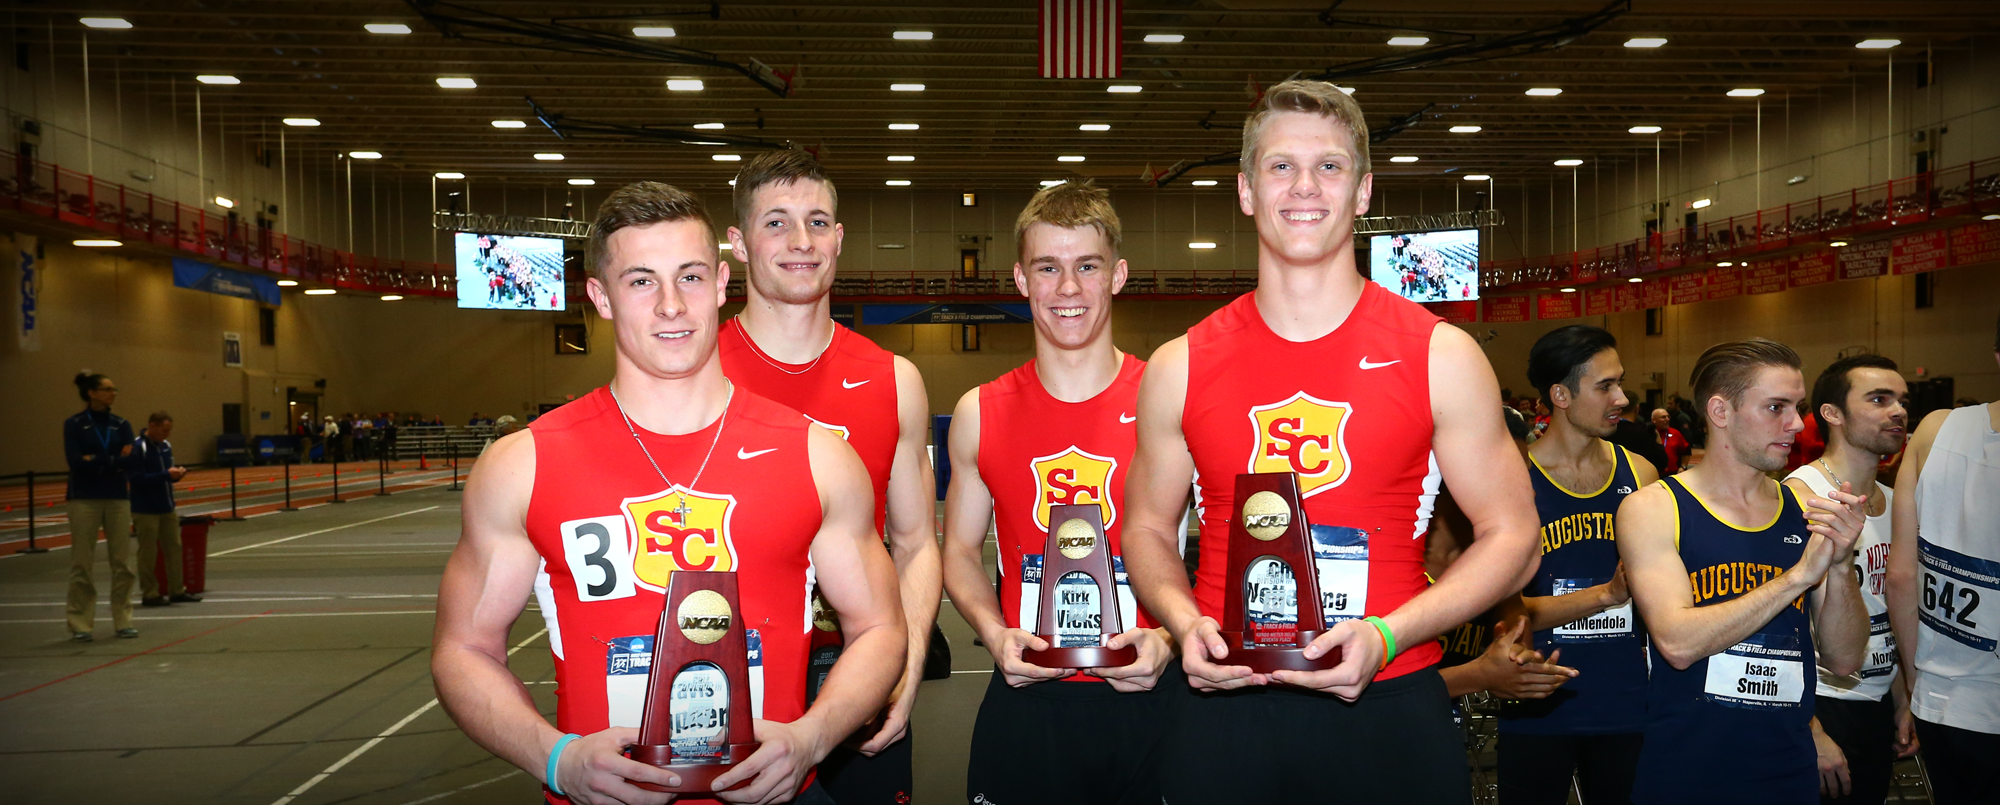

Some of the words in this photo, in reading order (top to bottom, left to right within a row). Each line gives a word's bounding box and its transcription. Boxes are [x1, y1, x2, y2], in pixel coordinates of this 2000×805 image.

[1266, 417, 1333, 478] SC
[1046, 468, 1100, 505] SC
[645, 509, 719, 572] SC
[1541, 512, 1615, 556] AUGUSTA
[1314, 543, 1364, 554] MPIONSHIPS
[575, 522, 617, 597] 3
[1062, 590, 1090, 605] Kirk
[1923, 572, 1980, 629] 642
[681, 615, 730, 630] NCAA
[1730, 645, 1746, 653] RACK
[630, 657, 652, 668] TRAC
[1745, 662, 1777, 677] Isaac
[1737, 677, 1779, 697] Smith
[1714, 695, 1731, 703] Division
